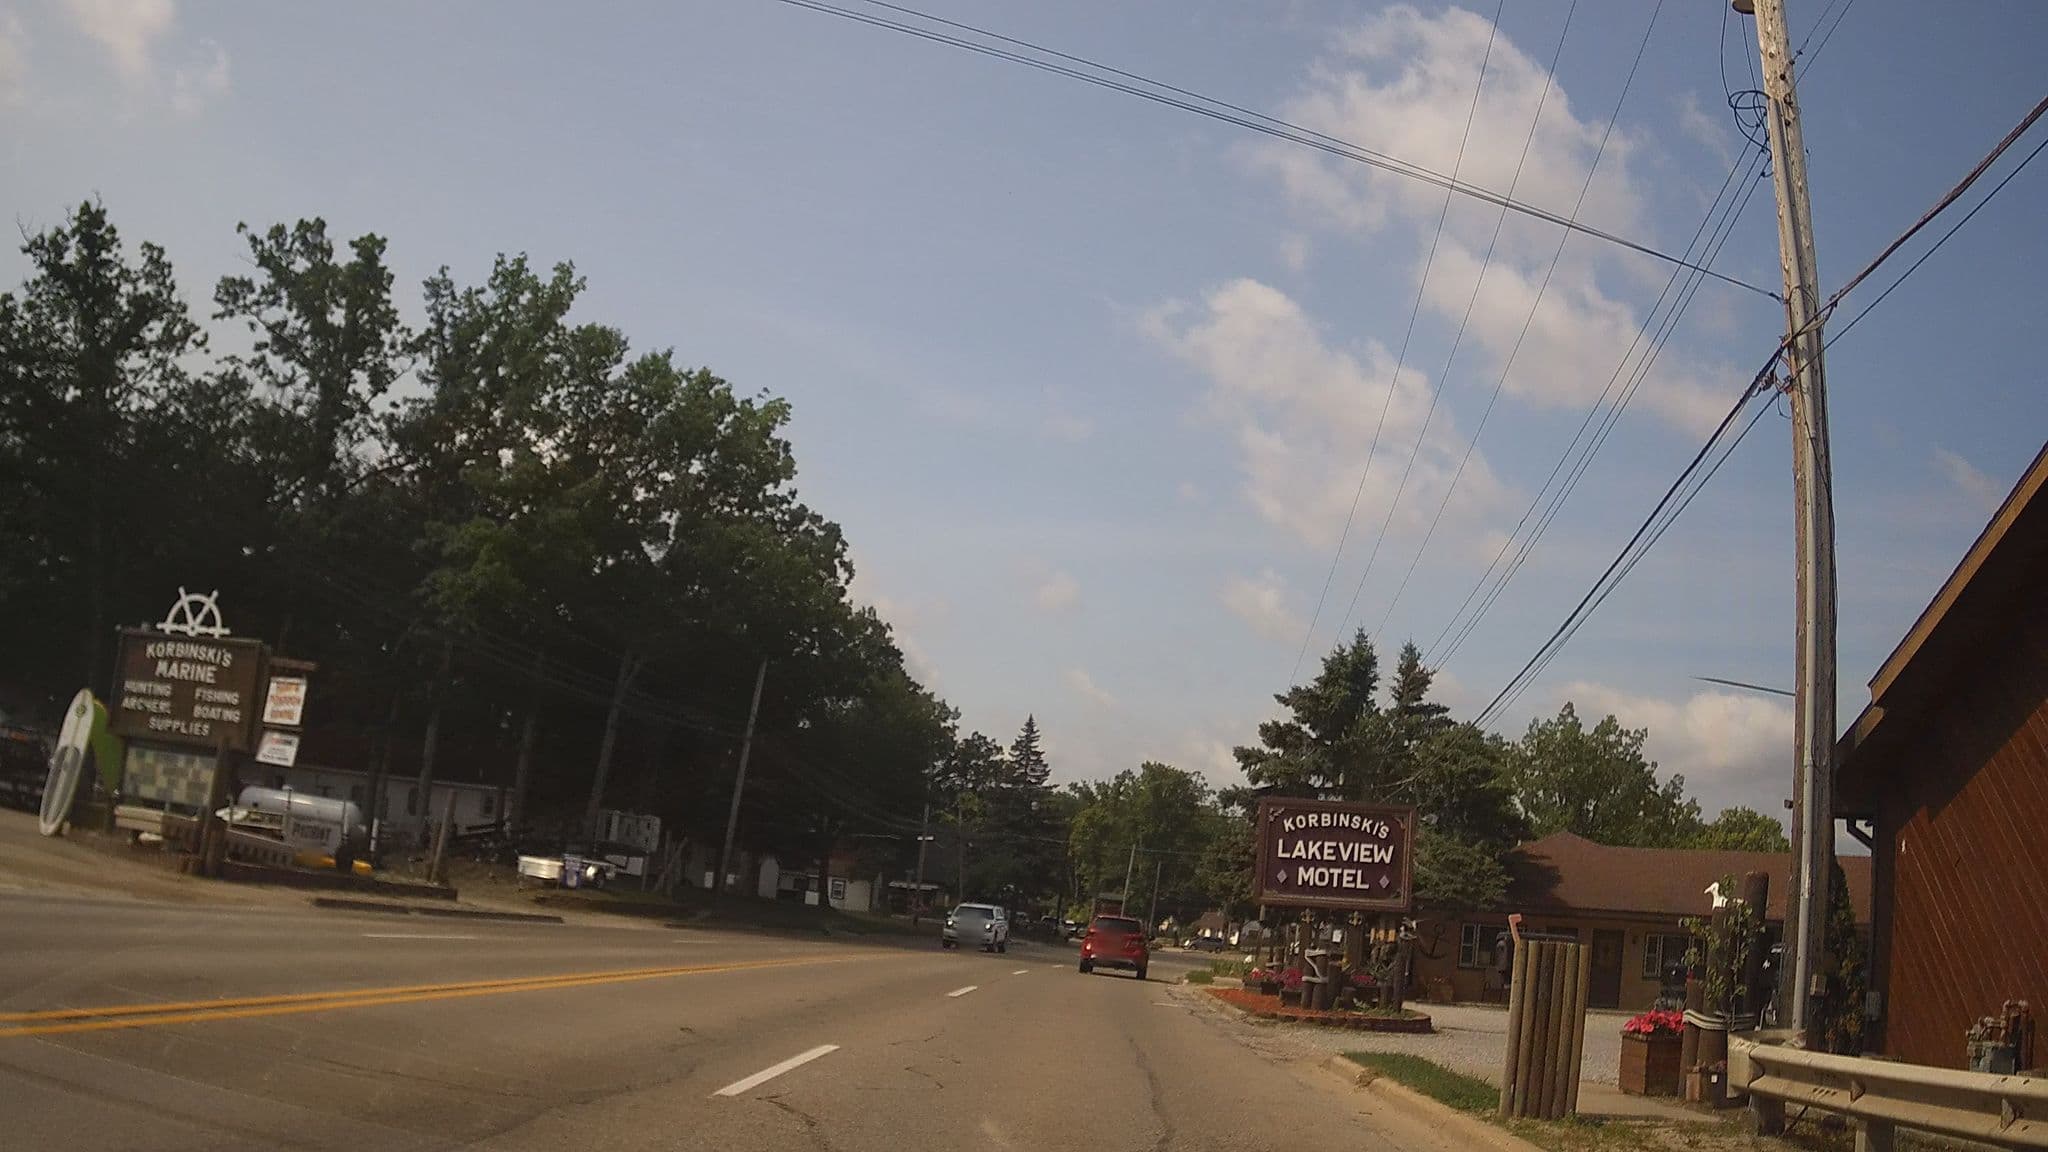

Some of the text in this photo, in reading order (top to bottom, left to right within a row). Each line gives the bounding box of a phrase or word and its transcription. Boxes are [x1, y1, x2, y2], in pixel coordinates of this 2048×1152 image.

[145, 641, 232, 668] KORBINSKI'S
[155, 660, 217, 684] MARINE
[124, 680, 240, 705] HUNTING FISHING
[193, 704, 240, 723] BOATING
[148, 716, 210, 737] SUPPLIES
[1283, 813, 1390, 839] KORBINSKI'S
[1277, 838, 1394, 864] LAKEVIEW
[1297, 866, 1369, 889] MOTEL
